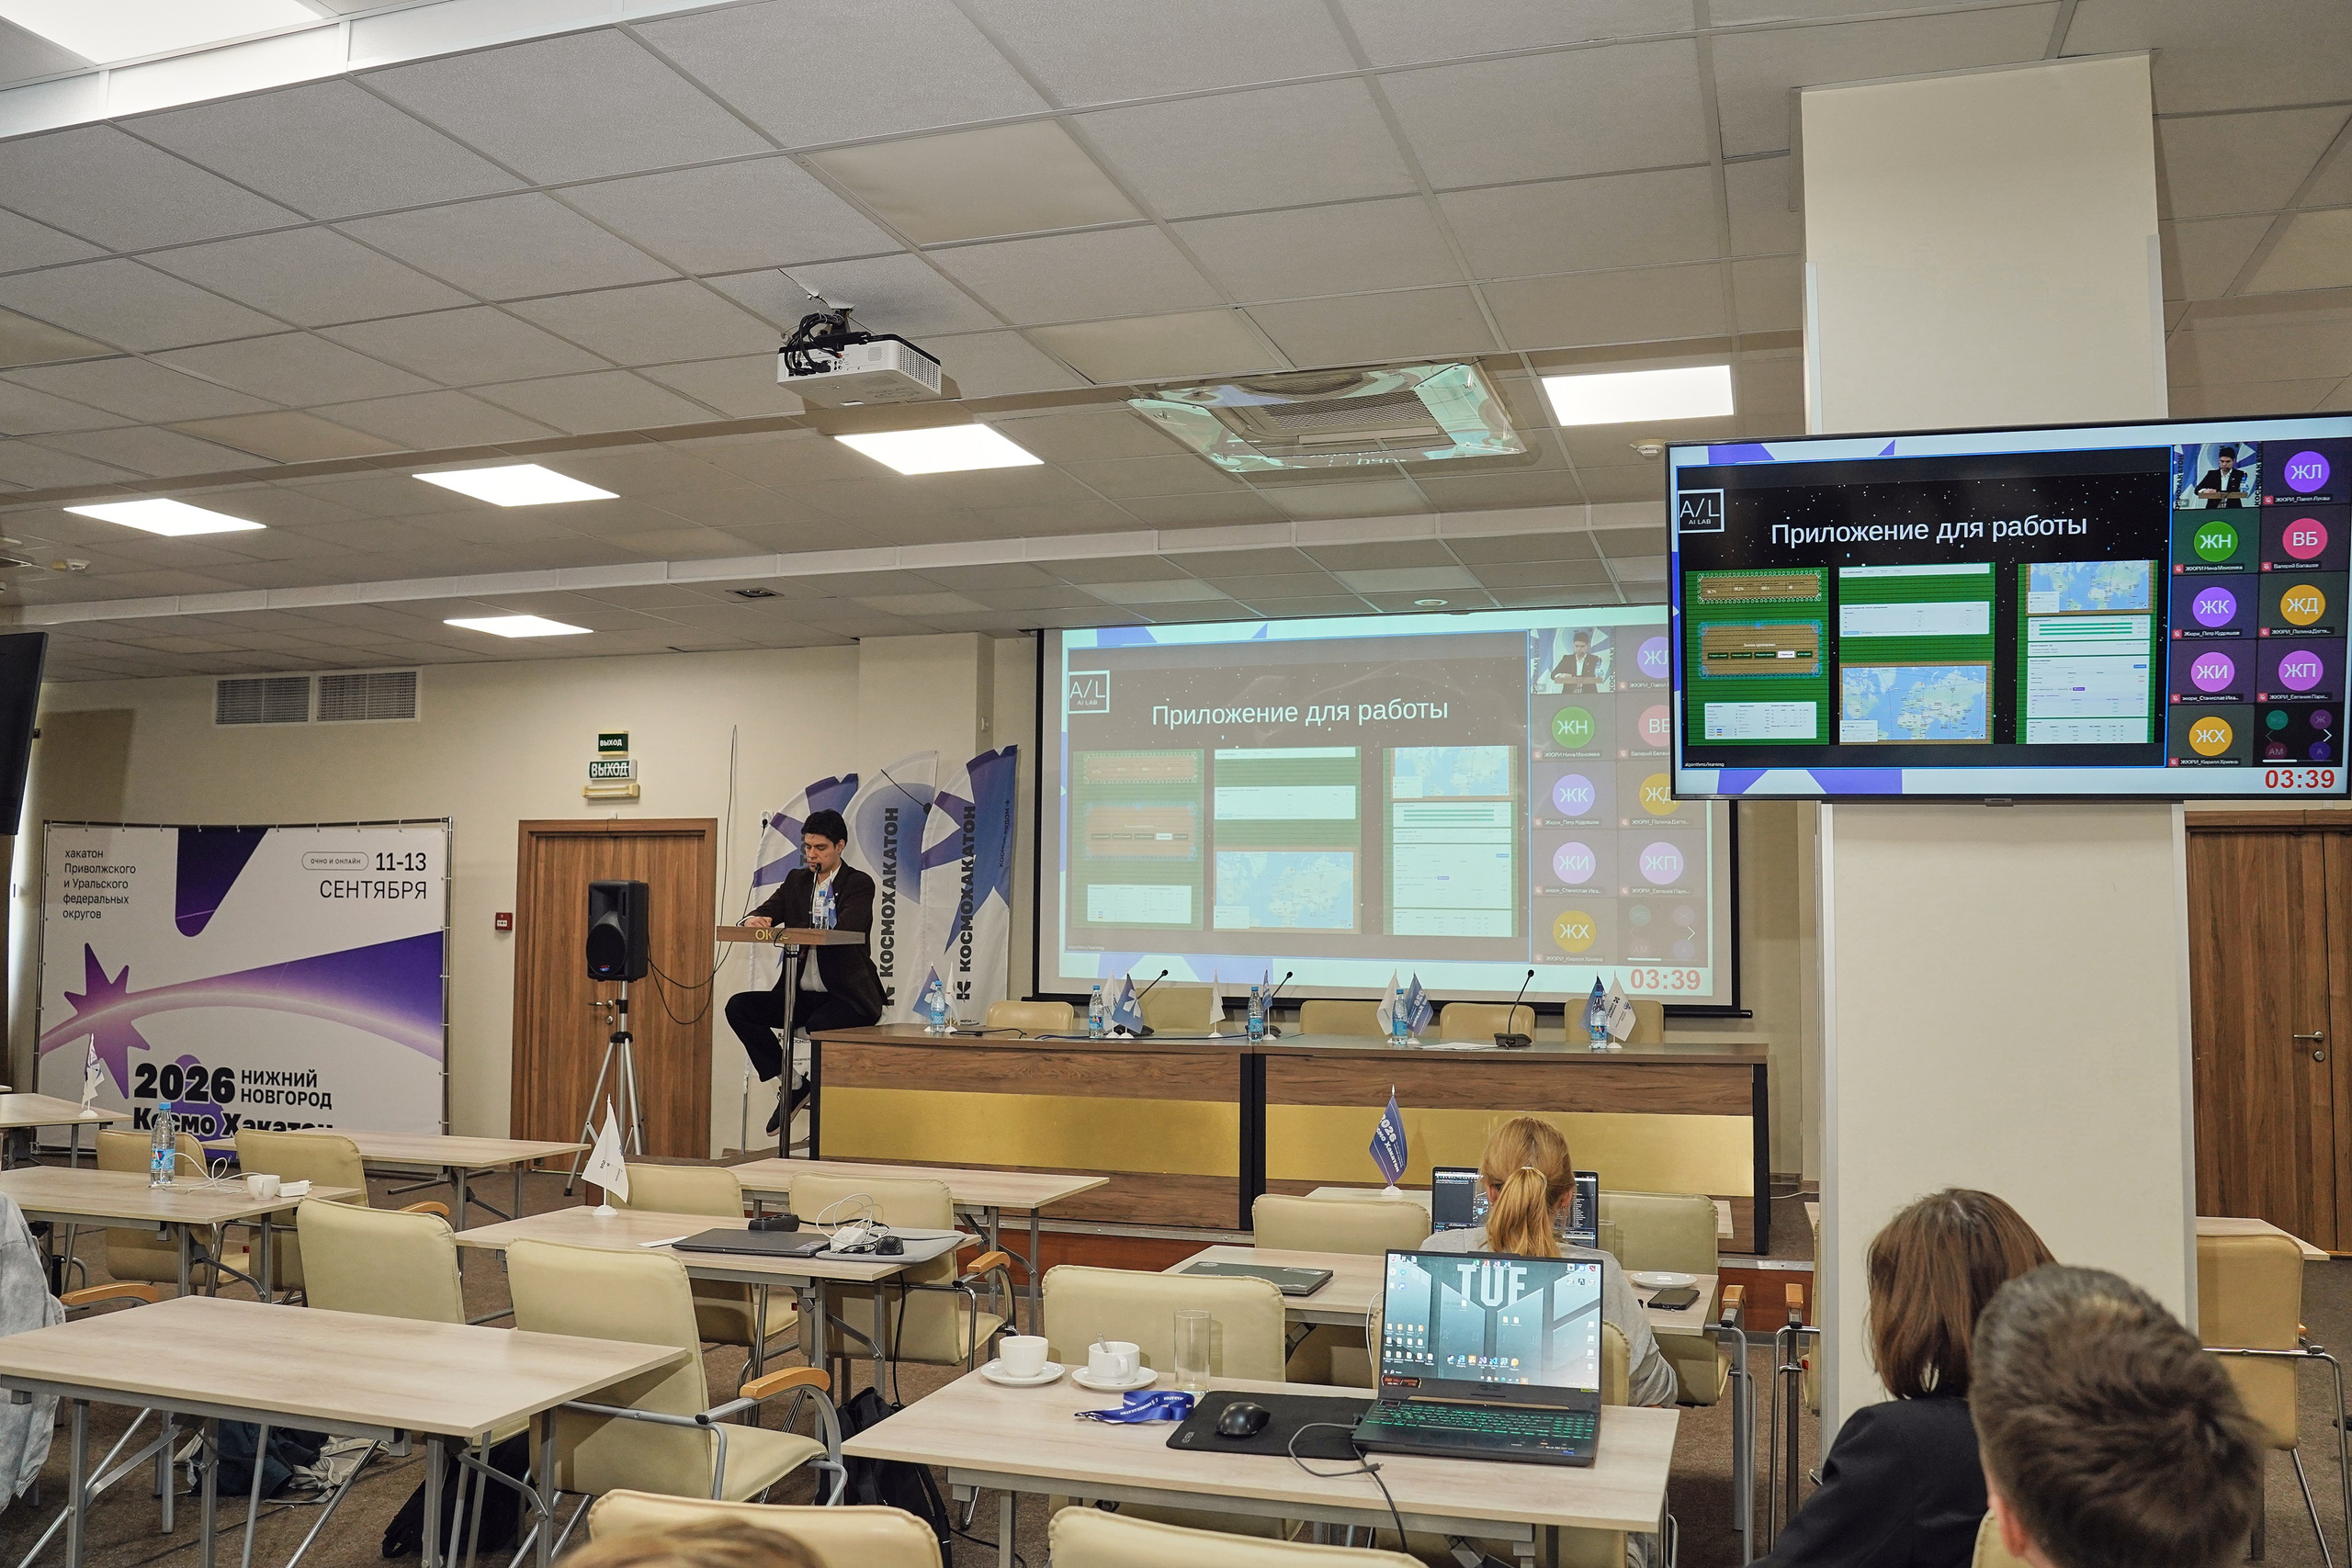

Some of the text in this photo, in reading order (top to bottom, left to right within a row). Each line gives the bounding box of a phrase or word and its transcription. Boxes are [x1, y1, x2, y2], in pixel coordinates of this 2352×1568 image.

[2291, 465, 2322, 479] ЖЛ
[1770, 513, 2087, 548] Приложение для работы
[2199, 534, 2232, 548] ЖН
[2292, 531, 2319, 547] ВБ
[2199, 600, 2230, 615] ЖК
[2287, 597, 2319, 615] ЖД
[2196, 665, 2228, 679] ЖИ
[2284, 663, 2317, 678] ЖП
[1152, 697, 1449, 730] Приложение для работы
[1557, 720, 1588, 735] ЖН
[2196, 728, 2226, 743] ЖХ
[599, 739, 623, 747] ВЫХОД
[591, 761, 628, 778] ВЫХОД
[2265, 769, 2335, 789] 03:39
[1560, 788, 1589, 802] ЖК
[65, 850, 104, 858] хакатон
[376, 852, 426, 872] 11-13
[64, 863, 136, 874] Приволжского
[1558, 855, 1589, 871] ЖИ
[1645, 855, 1677, 871] ЖП
[63, 878, 129, 890] и Уральского
[320, 879, 426, 899] СЕНТЯБРЯ
[879, 807, 899, 977] КОСМОХАКАТОН
[959, 806, 976, 972] КОСМОХАКАТОН
[62, 893, 130, 905] федеральных
[62, 908, 102, 920] округов
[1559, 924, 1589, 940] ЖХ
[1631, 968, 1702, 990] 03:39
[134, 1063, 235, 1103] 2026
[241, 1069, 318, 1088] НИЖНИЙ
[241, 1089, 333, 1110] НОВГОРОД
[1457, 1264, 1528, 1307] TUF
